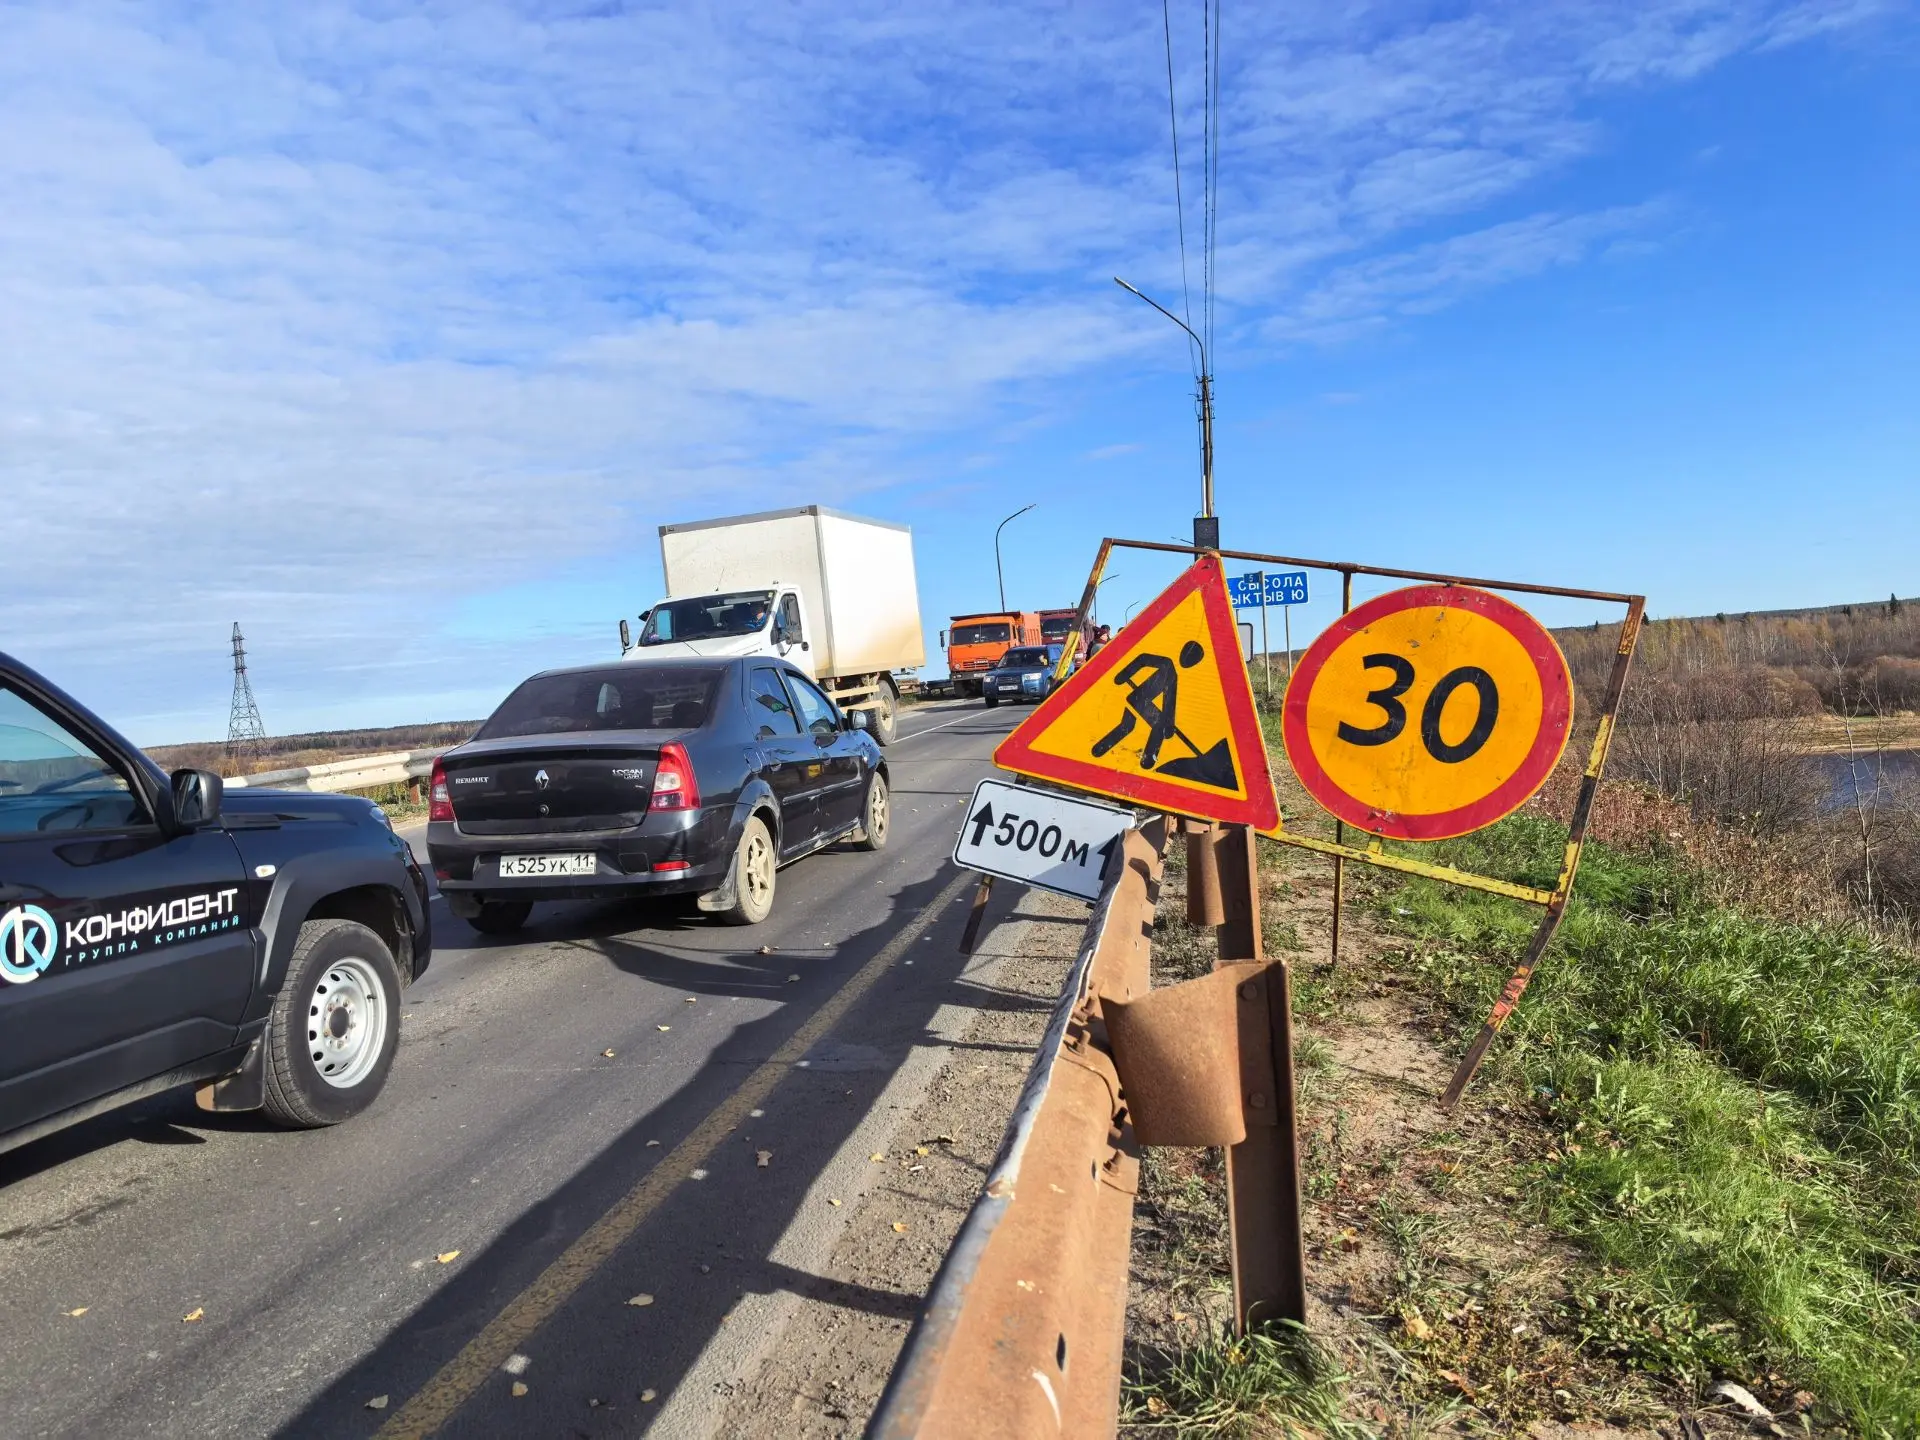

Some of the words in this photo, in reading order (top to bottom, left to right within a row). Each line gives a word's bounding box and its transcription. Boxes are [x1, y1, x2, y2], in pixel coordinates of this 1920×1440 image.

[1230, 591, 1284, 605] ЫКТЫВ
[1291, 589, 1304, 601] Ю
[1337, 653, 1500, 764] 30
[66, 888, 238, 949] КОНФИДЕНТ
[66, 942, 138, 966] ГРУППА
[155, 915, 239, 945] КОМПАНИЙ
